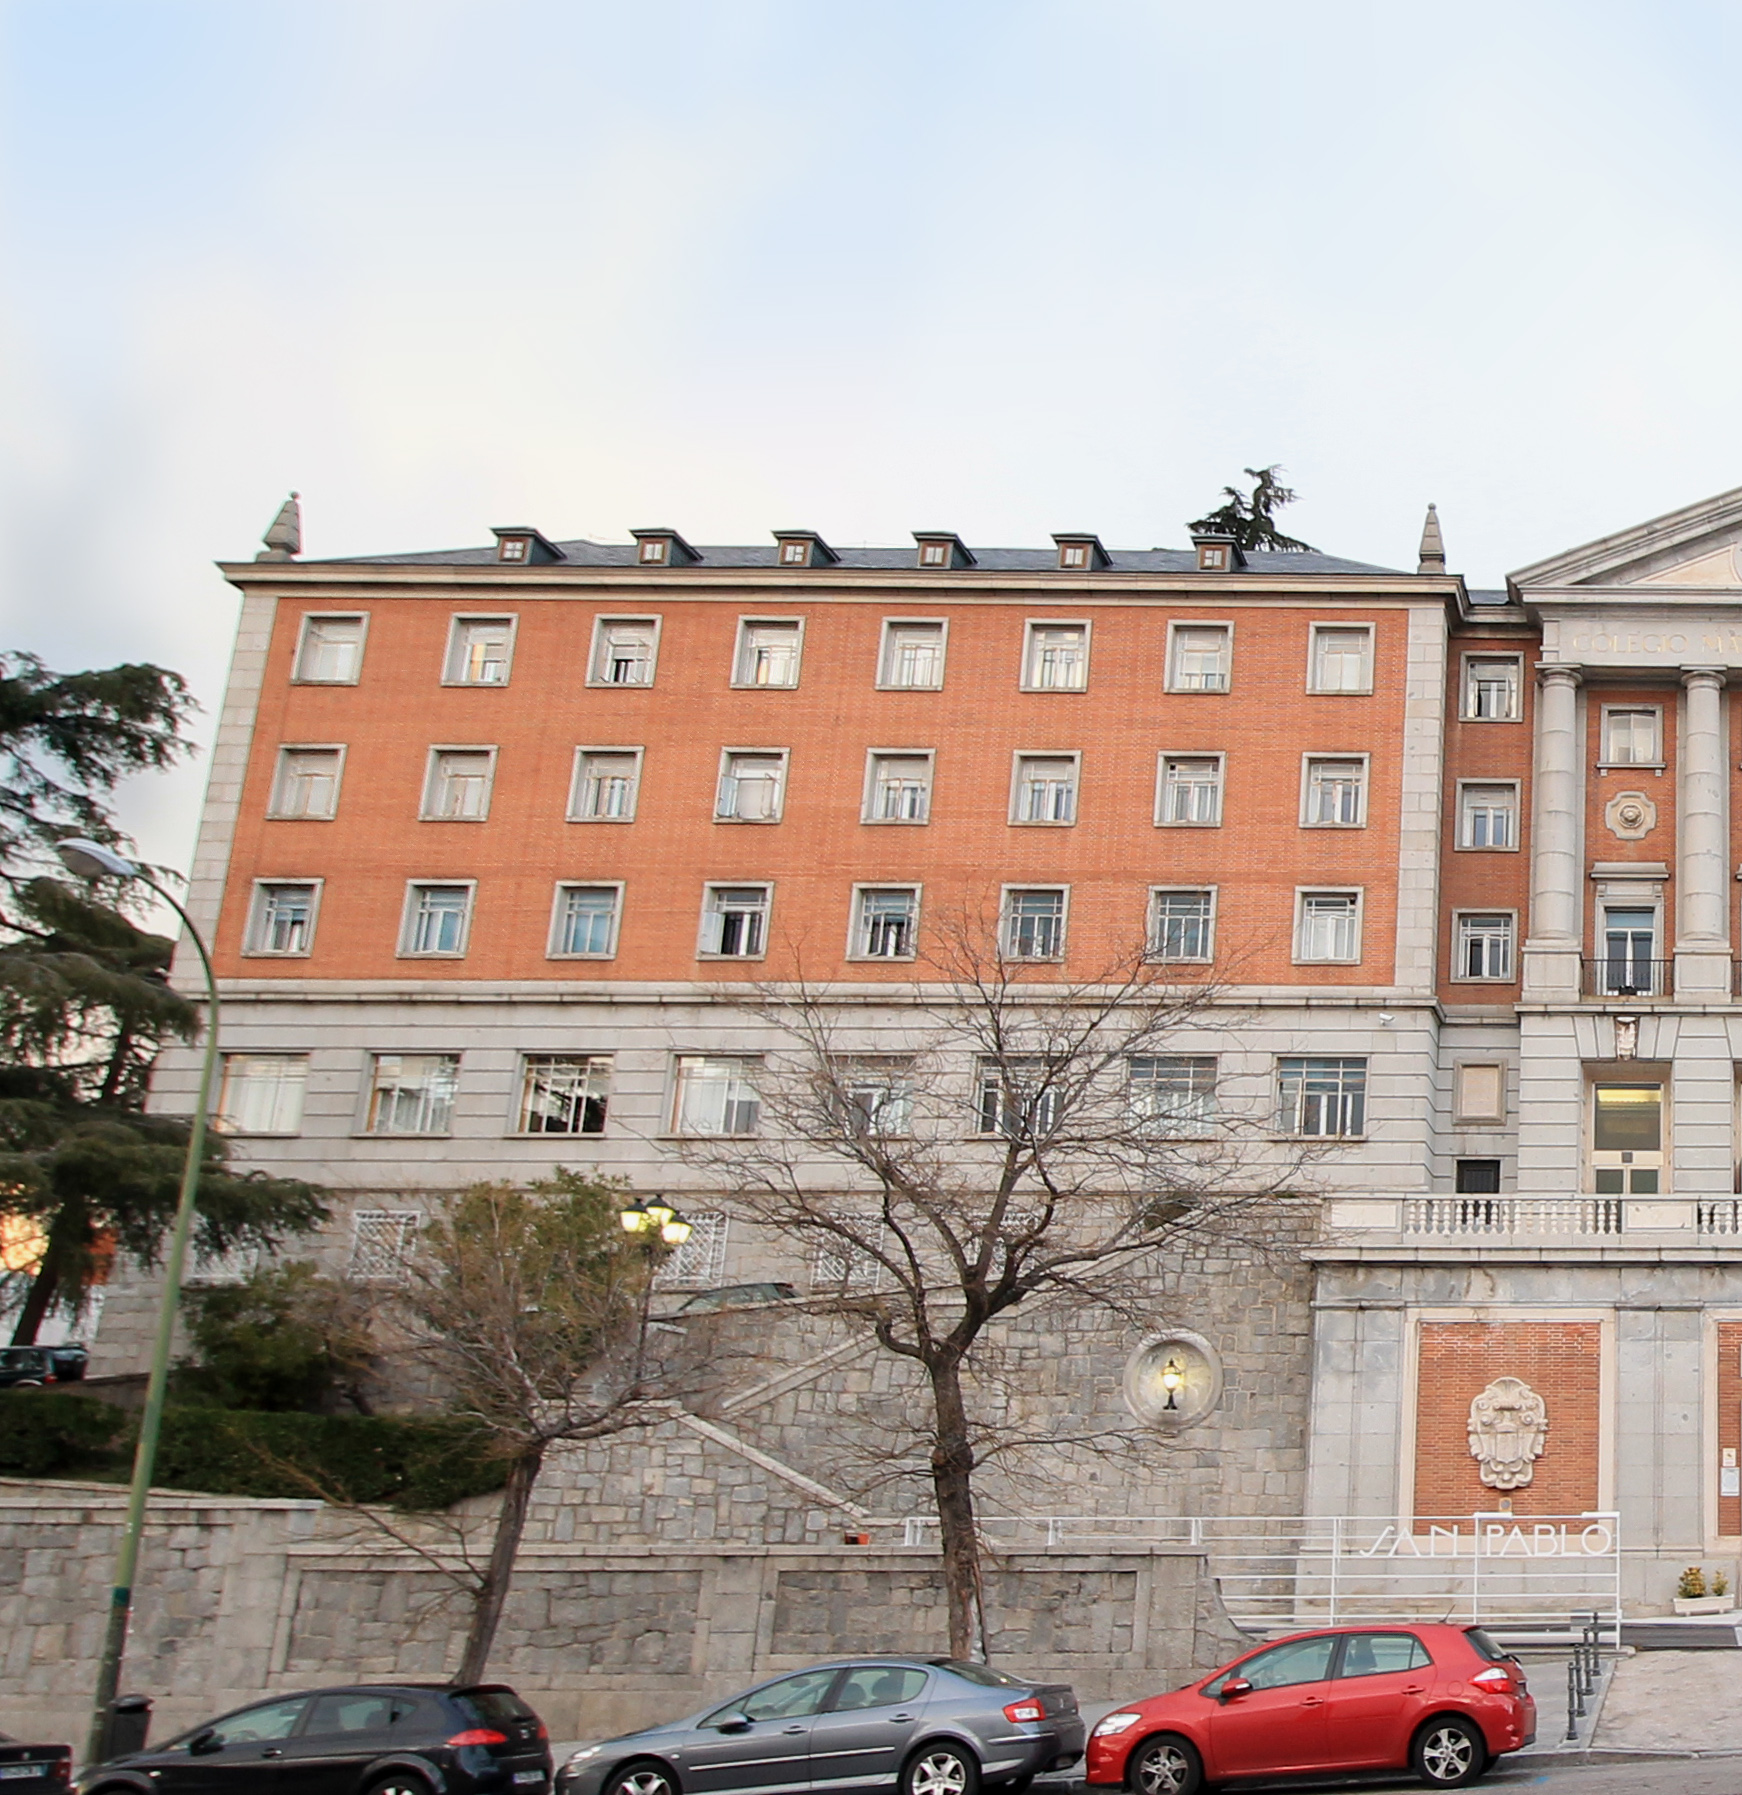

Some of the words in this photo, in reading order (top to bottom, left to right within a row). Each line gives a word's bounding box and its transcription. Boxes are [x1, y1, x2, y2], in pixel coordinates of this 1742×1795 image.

[1573, 633, 1688, 654] COLEGIO
[1359, 1525, 1459, 1557] SAN
[1486, 1524, 1612, 1557] PABLO
